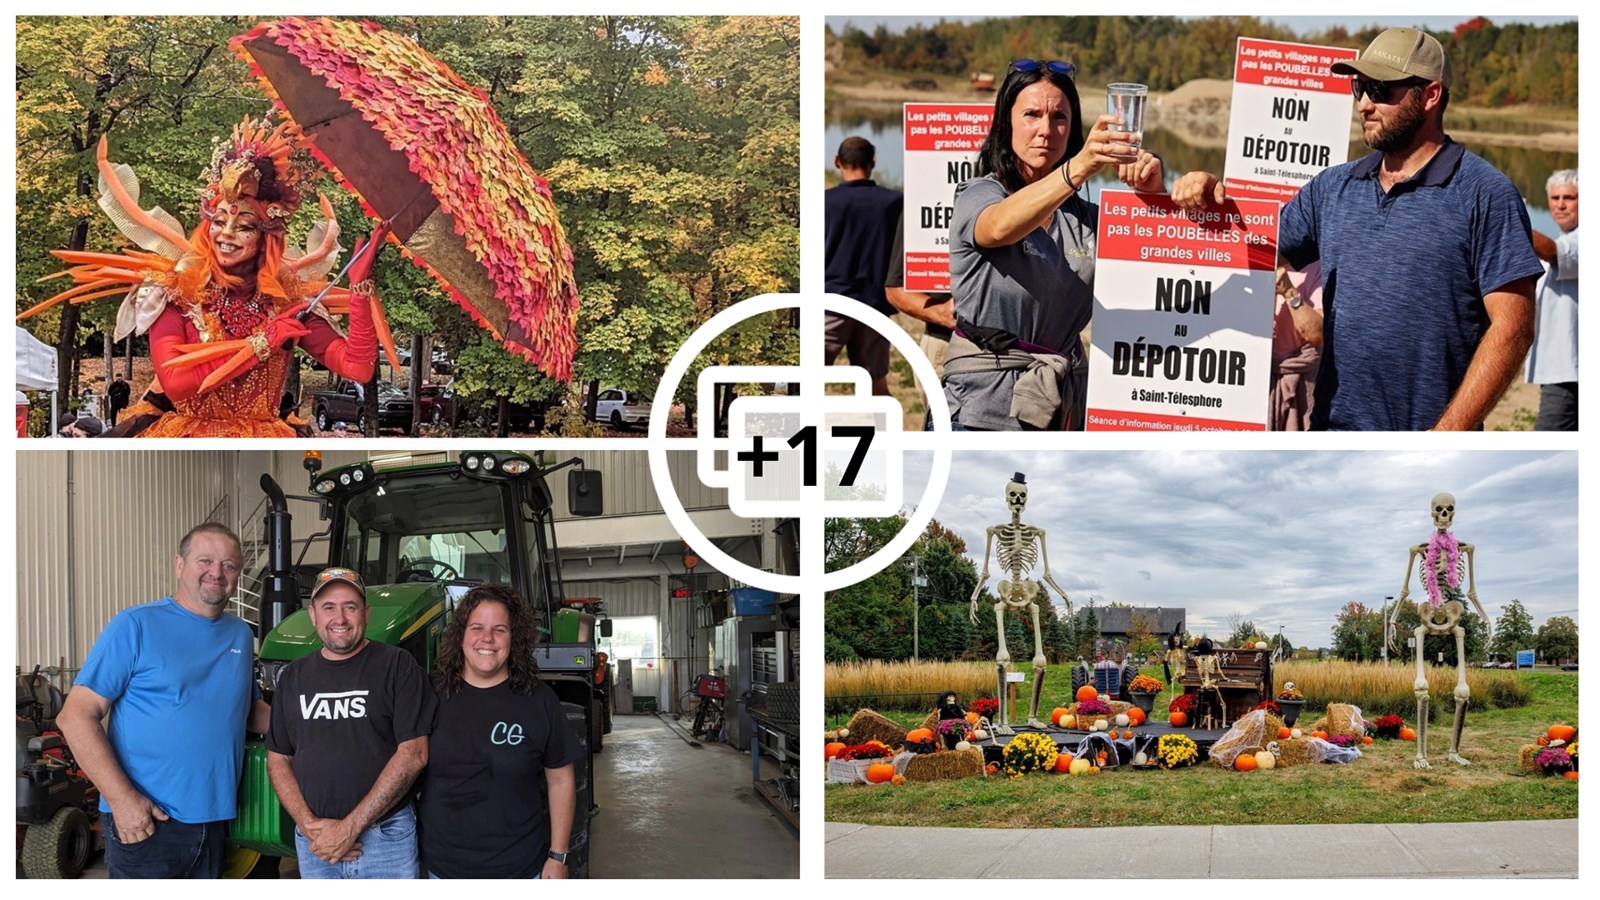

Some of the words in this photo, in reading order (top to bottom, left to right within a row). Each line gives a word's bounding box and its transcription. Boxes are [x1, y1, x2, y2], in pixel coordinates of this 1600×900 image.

[1240, 46, 1256, 56] Les
[1258, 48, 1282, 59] petits
[1284, 51, 1318, 64] villages
[1320, 56, 1331, 66] ne
[1242, 60, 1258, 70] pas
[1260, 61, 1272, 71] les
[1274, 62, 1331, 77] POUBELLES
[1263, 75, 1299, 86] grandes
[1301, 78, 1324, 89] villes
[907, 111, 924, 122] Les
[926, 112, 952, 123] petits
[953, 112, 989, 124] villages
[1272, 96, 1310, 122] NON
[911, 126, 927, 136] pas
[929, 125, 943, 135] les
[945, 125, 989, 135] POUBELL
[1284, 127, 1293, 135] AU
[934, 139, 972, 150] grandes
[1242, 134, 1331, 167] DÉPOTOIR
[1104, 202, 1128, 216] Les
[1131, 204, 1167, 219] petits
[1170, 207, 1221, 224] villages
[1225, 213, 1241, 224] ne
[1244, 214, 1274, 227] sont
[1107, 224, 1131, 237] pas
[1134, 223, 1153, 237] les
[1156, 224, 1240, 243] POUBELLES
[1243, 231, 1268, 245] des
[1140, 246, 1194, 260] grandes
[1197, 248, 1232, 262] villes
[1155, 277, 1212, 315] NON
[1174, 324, 1188, 337] AU
[1112, 336, 1247, 386] DÉPOTOIR
[1131, 388, 1138, 401] à
[1138, 389, 1222, 408] Saint-Télesphore
[1089, 415, 1118, 426] Séance
[1119, 418, 1171, 430] d'information
[299, 690, 369, 719] VANS
[490, 721, 525, 745] CG
